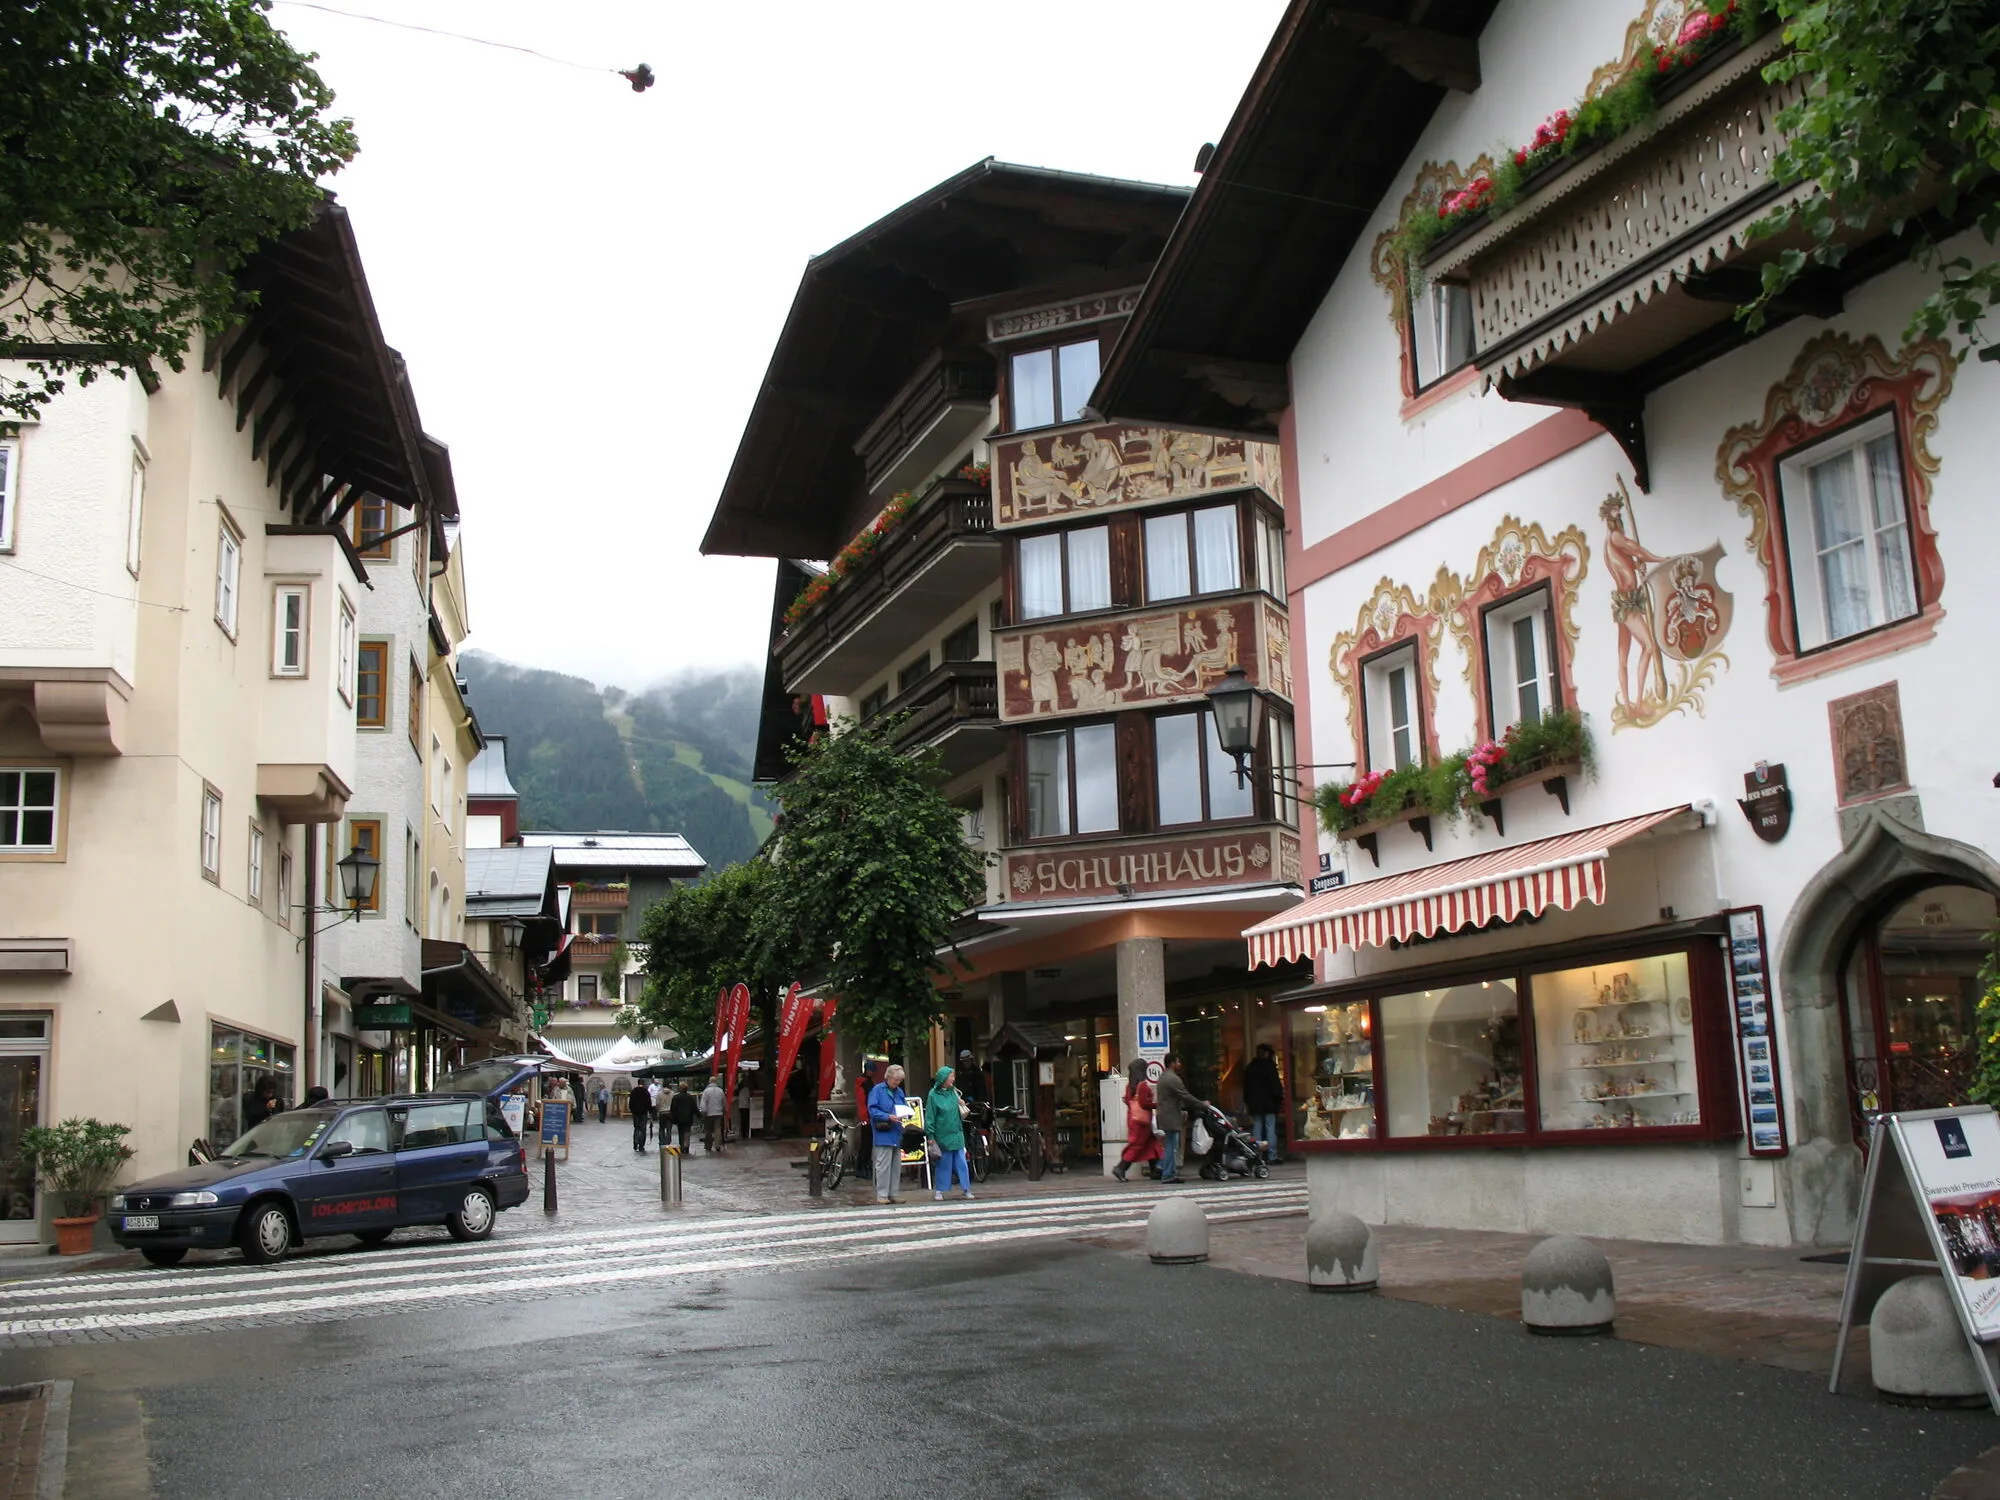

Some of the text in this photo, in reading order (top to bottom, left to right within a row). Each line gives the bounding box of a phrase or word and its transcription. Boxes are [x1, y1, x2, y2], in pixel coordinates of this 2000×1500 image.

[1036, 841, 1245, 895] SCHUHHAUS
[1925, 1183, 1961, 1195] Swarovski
[1962, 1180, 1995, 1191] Premium
